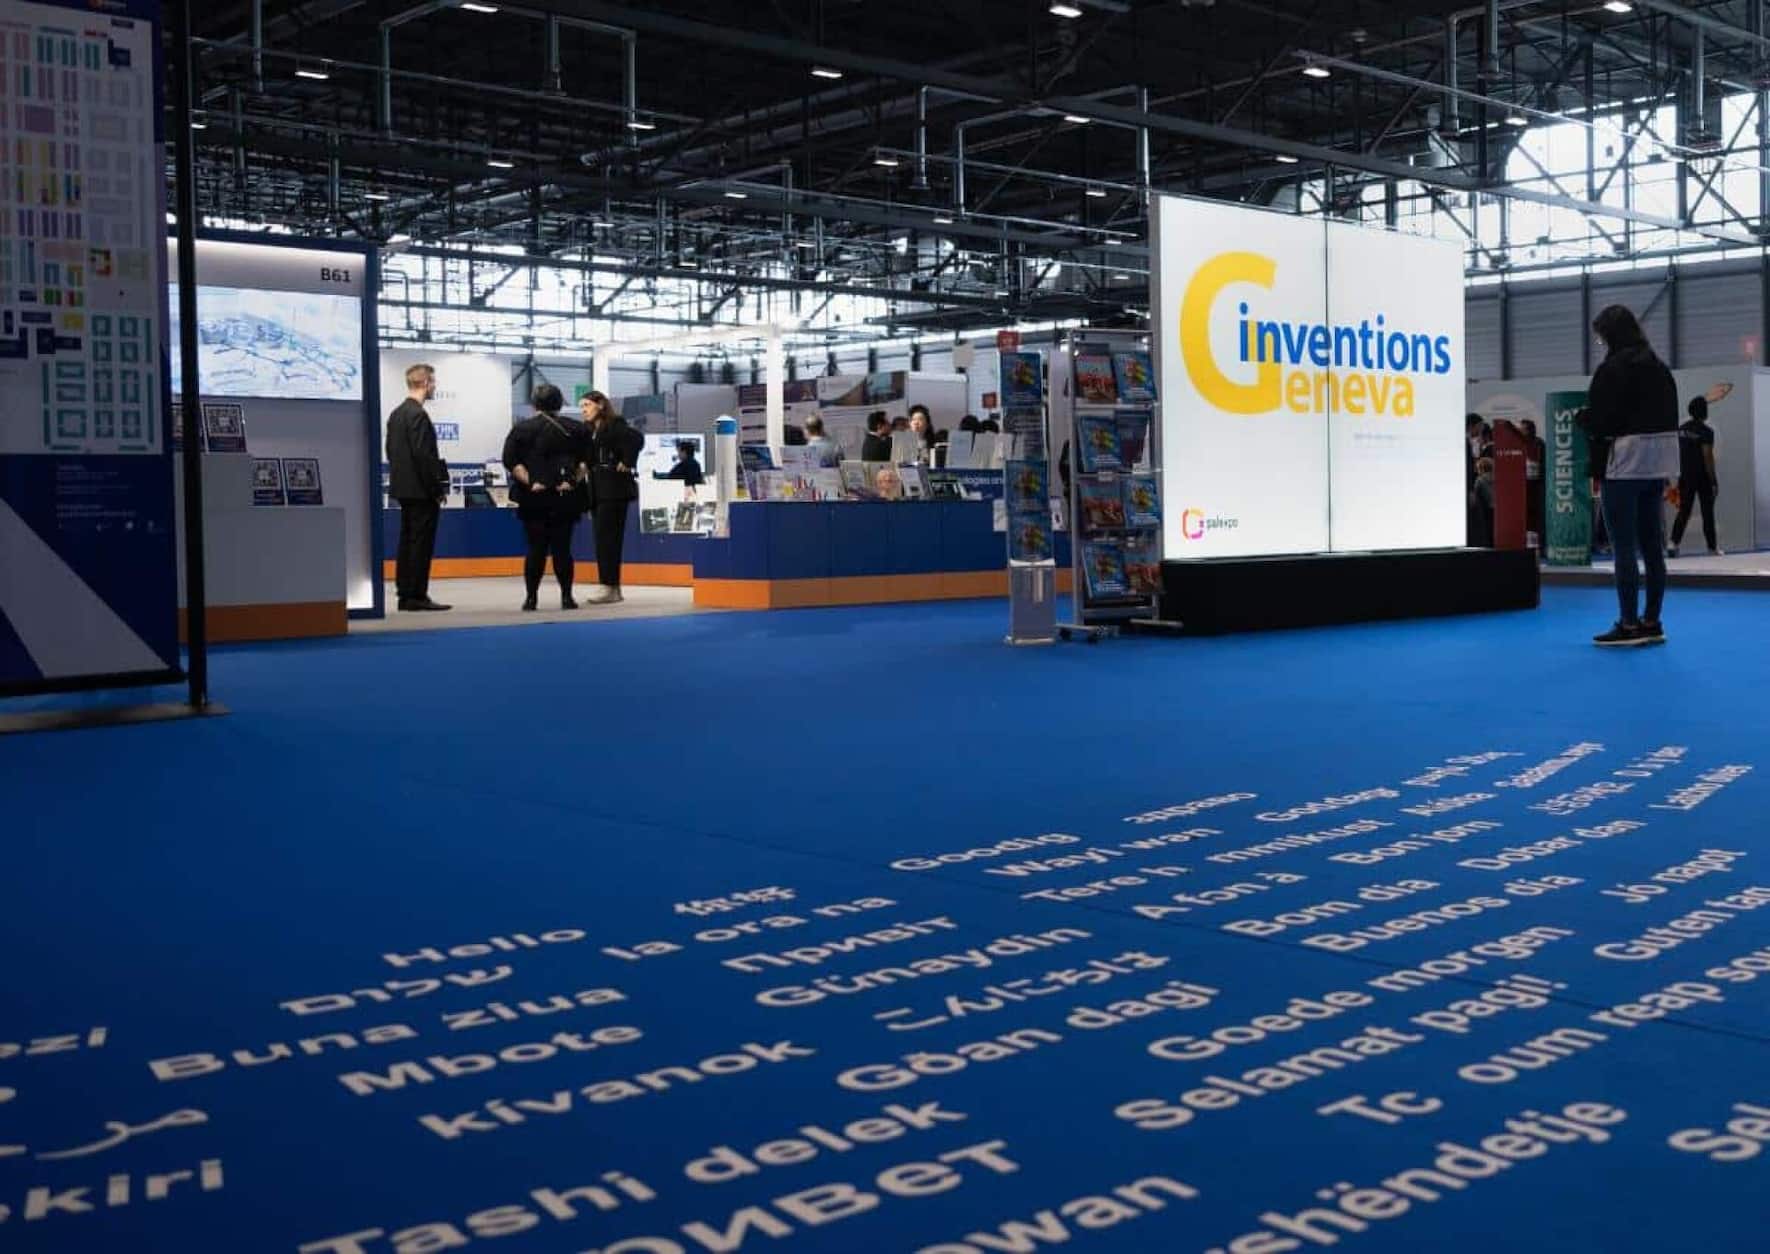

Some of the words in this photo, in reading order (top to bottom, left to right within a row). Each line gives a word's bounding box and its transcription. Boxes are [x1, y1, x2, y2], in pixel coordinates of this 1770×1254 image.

[320, 268, 351, 282] B61
[1239, 302, 1451, 374] inventions
[1554, 409, 1574, 513] SCIENCES
[383, 928, 587, 968] Hello
[693, 915, 809, 943] ora
[811, 896, 897, 918] na
[1220, 900, 1364, 937] Bom
[1300, 896, 1511, 953] Buenos
[1593, 910, 1736, 961] Guten
[873, 951, 1171, 1031] こんにちは
[1146, 990, 1375, 1061] Goede
[1366, 925, 1575, 992] morgen
[1588, 981, 1725, 1030] reap
[148, 1023, 418, 1081] Buna
[441, 987, 627, 1031] ziua
[338, 1025, 643, 1097] Mbote
[1113, 1025, 1425, 1130] Selamat
[0, 1158, 224, 1222] kiri
[298, 1170, 657, 1254] Tashi
[683, 1101, 968, 1183] delek
